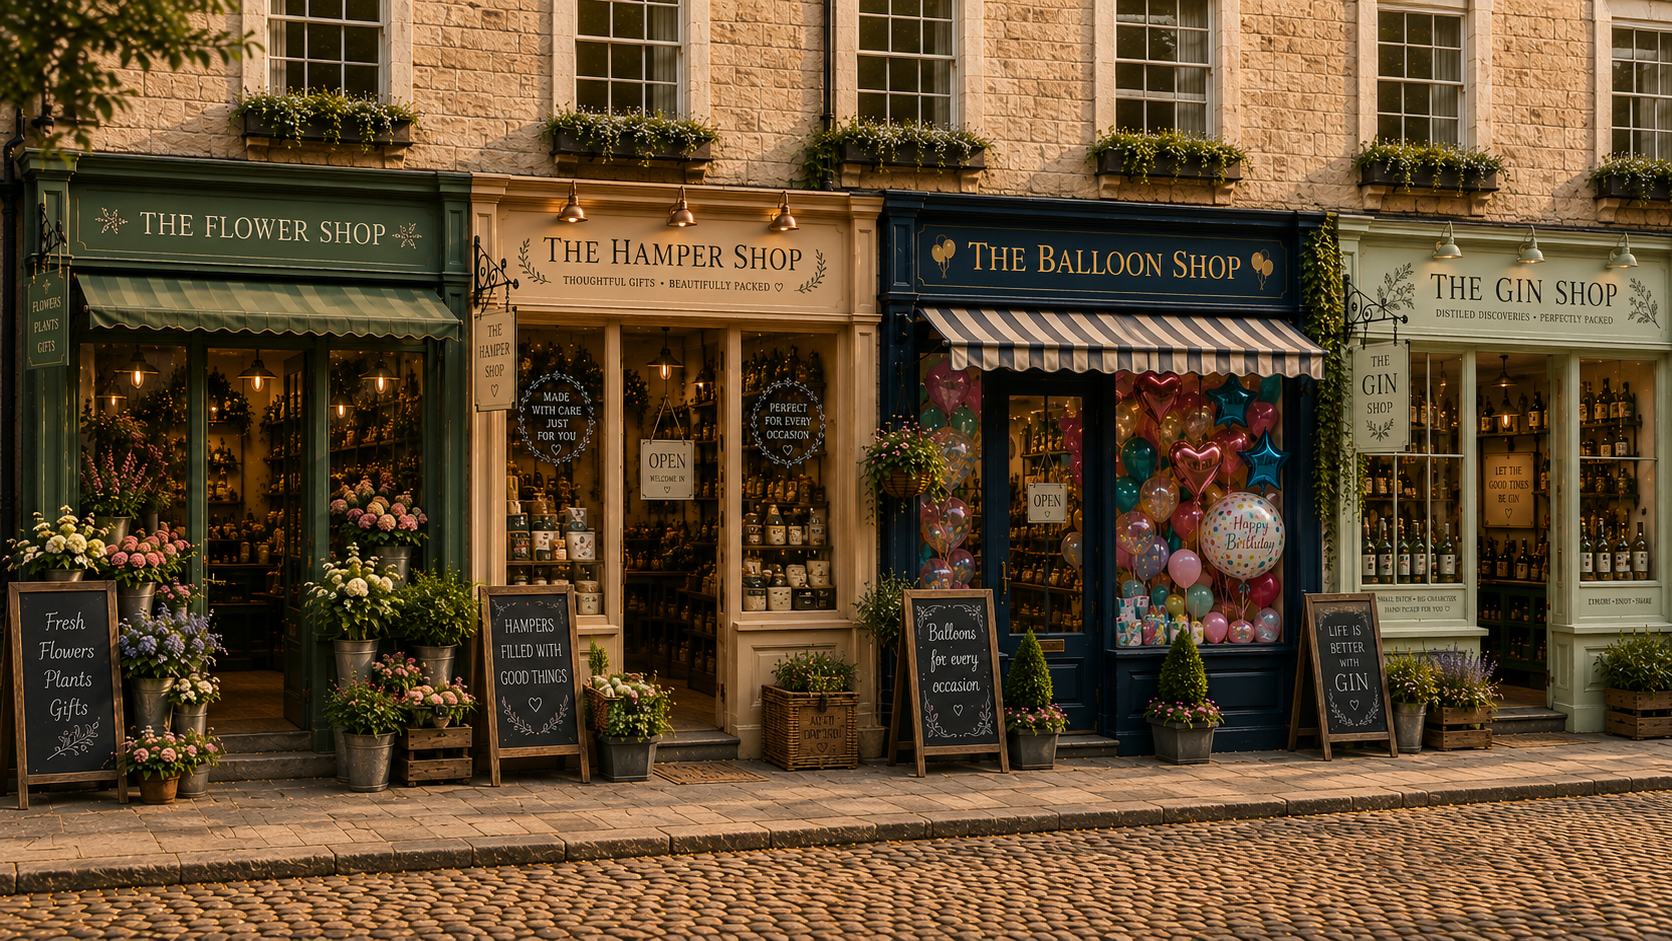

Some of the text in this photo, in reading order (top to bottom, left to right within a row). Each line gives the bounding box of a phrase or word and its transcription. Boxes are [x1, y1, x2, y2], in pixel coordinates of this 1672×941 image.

[140, 212, 386, 245] THE FLOWER SHOP
[543, 236, 802, 271] THE HAMPER SHOP
[968, 241, 1241, 280] THE BALLOON SHOP
[563, 276, 770, 292] THOUGHTFUL GIFTS BEAUTIFULLY PACKED
[1430, 273, 1618, 307] THE GIN SHOP
[32, 297, 61, 313] FLOWERS
[1478, 310, 1530, 321] DISCOVERIES
[1540, 313, 1582, 323] PERFECTLY
[1584, 315, 1614, 325] PACKED
[34, 318, 59, 334] PLANTS
[488, 323, 503, 338] THE
[37, 340, 55, 353] GIFTS
[480, 342, 510, 359] HAMPER
[1370, 354, 1390, 368] THE
[485, 364, 505, 378] SHOP
[1362, 372, 1398, 396] GIN
[544, 392, 570, 402] MADE
[532, 405, 582, 416] WITH CARE
[770, 403, 807, 413] PERFECT
[1367, 402, 1393, 415] SHOP
[546, 419, 569, 428] JUST
[765, 416, 812, 426] FOR EVERY
[538, 432, 576, 441] FOR YOU
[766, 430, 809, 440] OCCASION
[649, 453, 686, 469] OPEN
[1496, 466, 1522, 476] LET THE
[1489, 480, 1508, 490] GOOD
[1034, 494, 1061, 508] OPEN
[1498, 494, 1520, 503] BE GIN
[1234, 514, 1269, 537] Happy
[45, 611, 87, 632] Fresh
[504, 618, 555, 634] HAMPERS
[927, 622, 977, 642] Balloons
[1328, 625, 1362, 637] LIFE IS
[38, 640, 95, 661] Flowers
[501, 643, 562, 659] FILLED WITH
[1330, 641, 1365, 654] BETTER
[930, 649, 980, 673] for every
[1339, 658, 1360, 668] WITH
[44, 669, 93, 689] Plants
[500, 668, 568, 686] GOOD THINGS
[1334, 672, 1369, 693] GIN
[932, 678, 981, 694] occasion
[50, 698, 89, 722] Gifts
